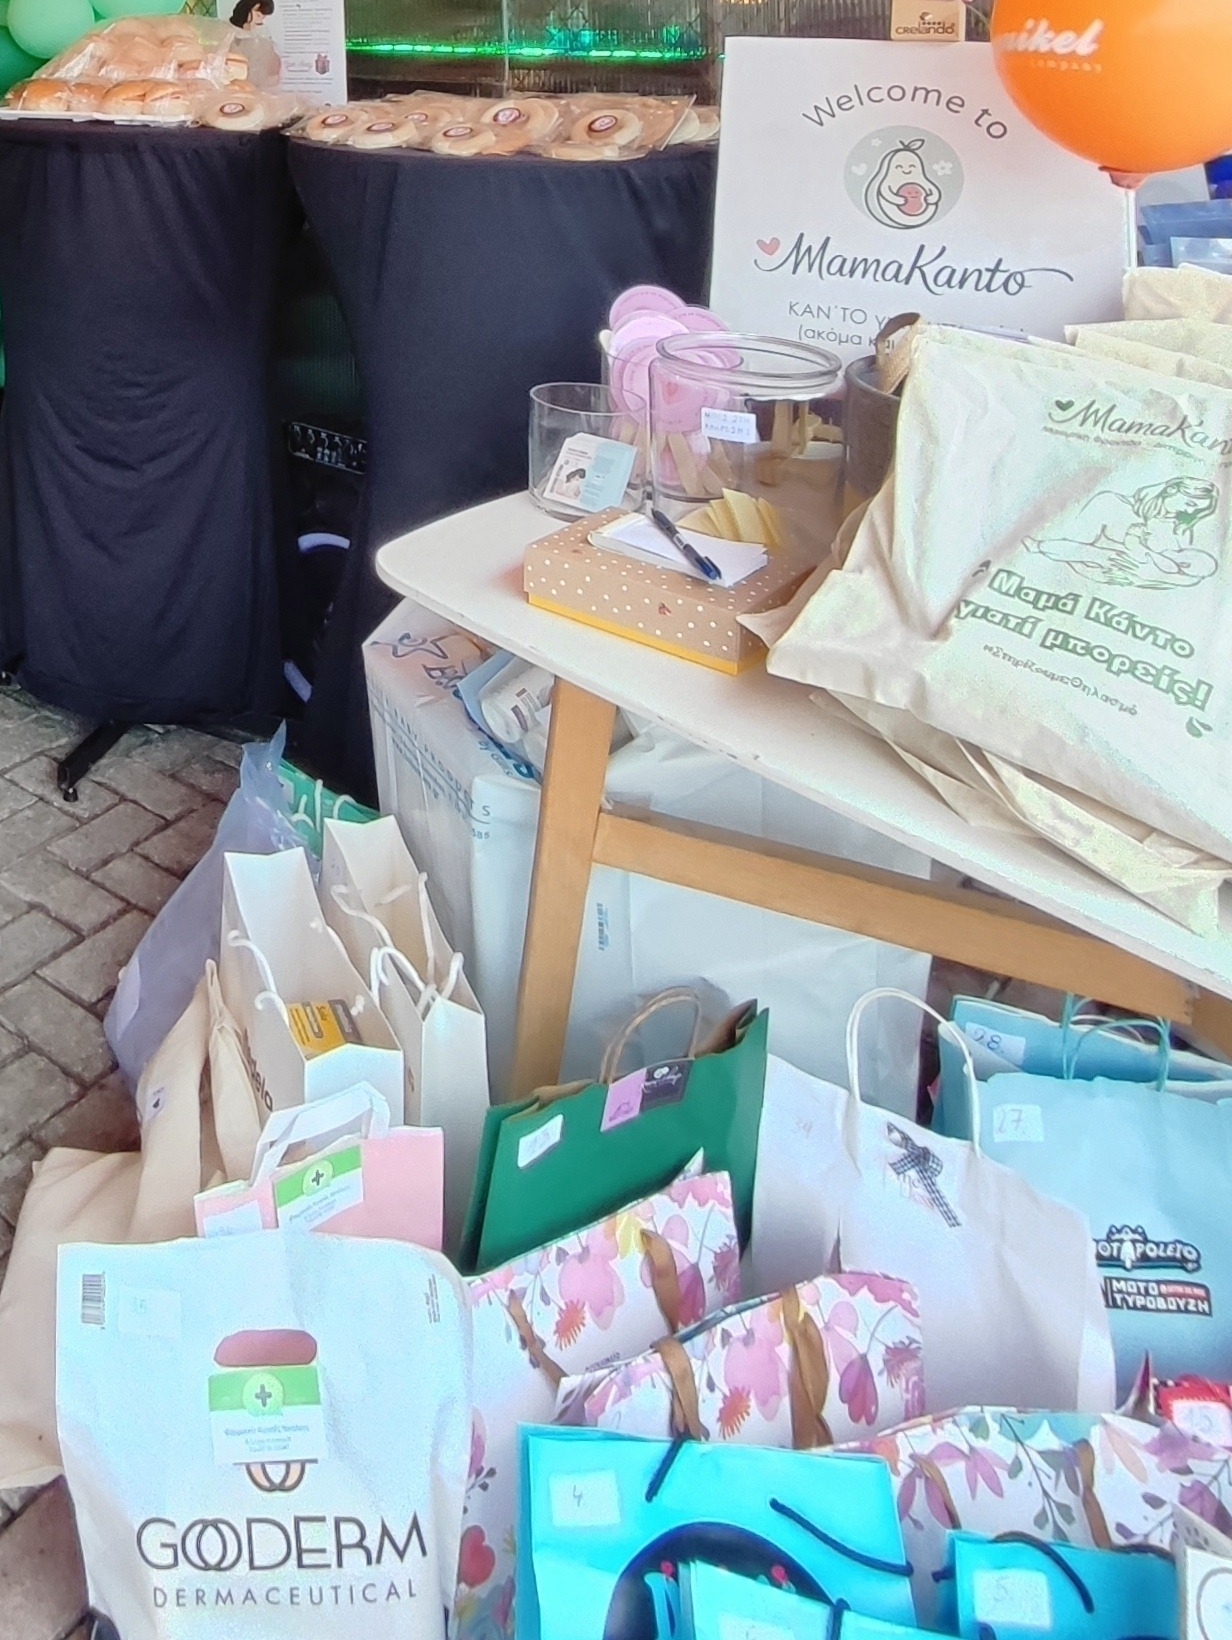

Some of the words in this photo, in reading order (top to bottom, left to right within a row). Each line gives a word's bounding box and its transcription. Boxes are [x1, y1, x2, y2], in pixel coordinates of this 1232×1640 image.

[802, 83, 966, 128] Welcome
[973, 107, 1008, 141] to
[754, 232, 1074, 297] MamaKanto
[798, 323, 863, 347] (ακόμα
[988, 568, 1082, 615] Μαμά
[1084, 596, 1194, 659] Κάντο
[955, 599, 1043, 639] γιατί
[1039, 628, 1213, 712] μπορείς!
[136, 1511, 428, 1572] GOODERM
[152, 1578, 417, 1609] DERMACEUTICAL
